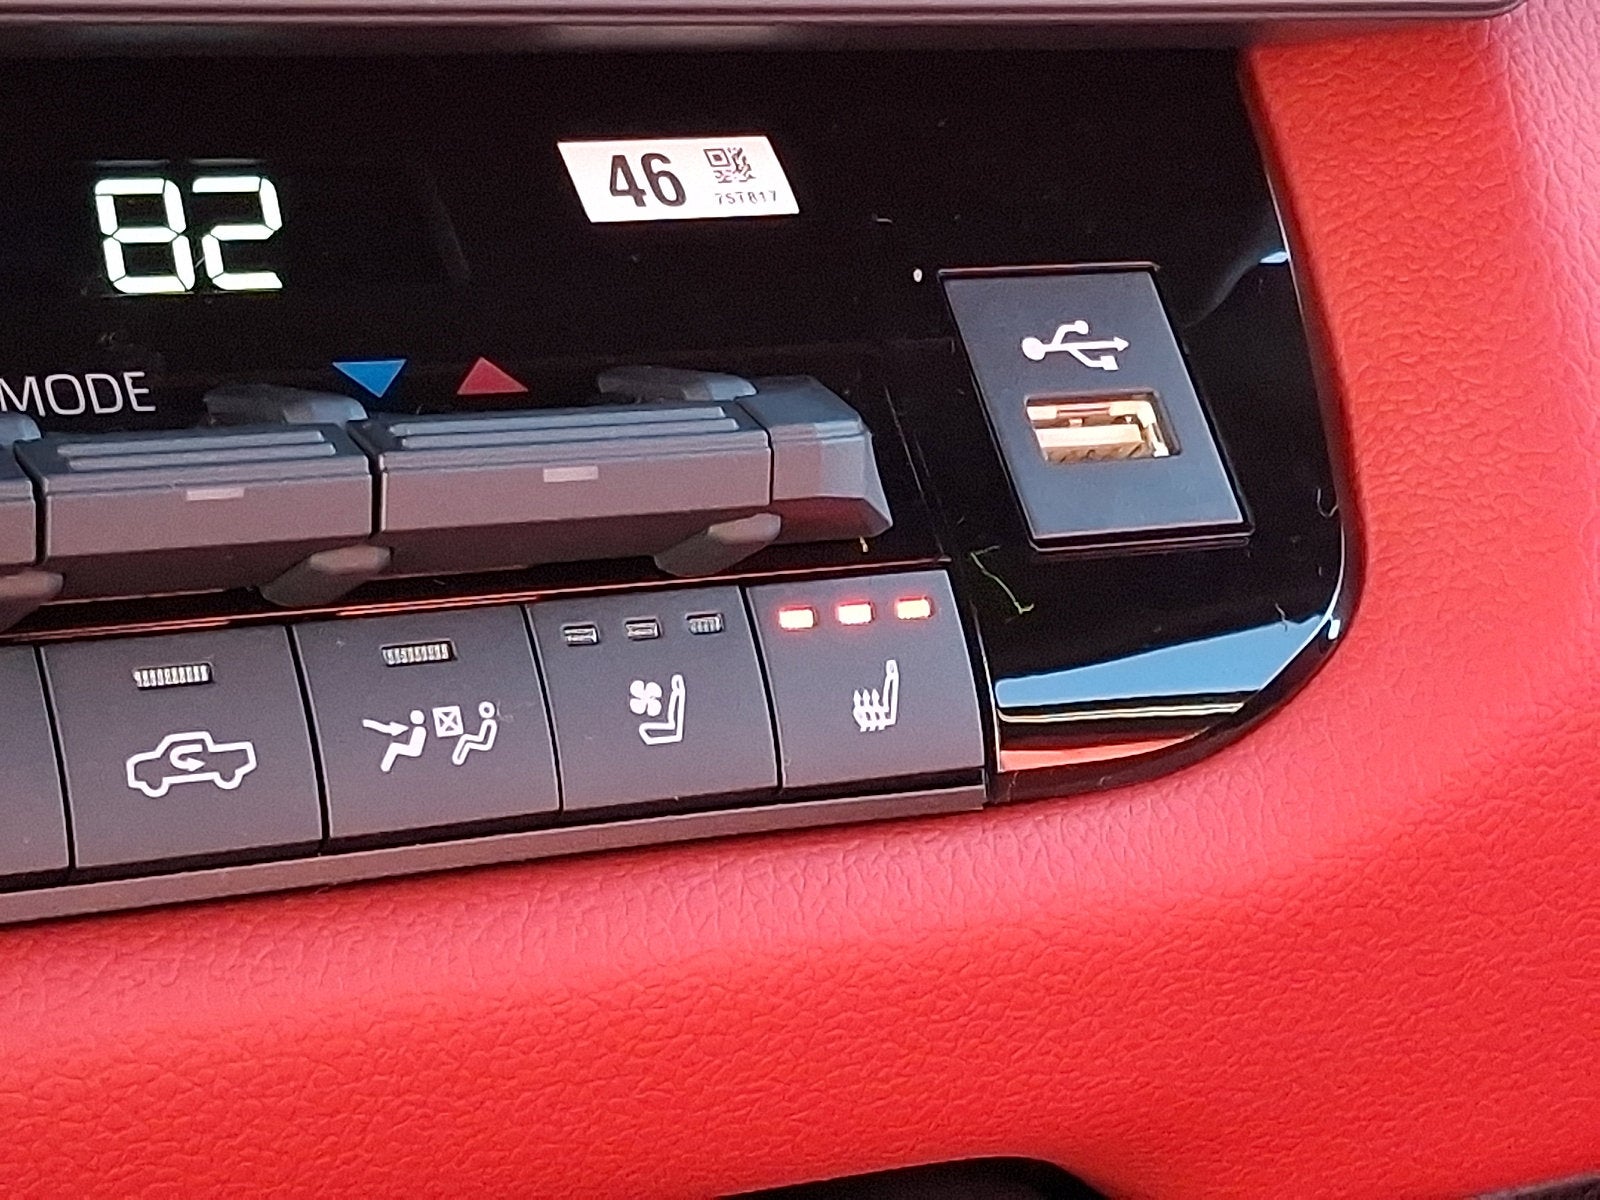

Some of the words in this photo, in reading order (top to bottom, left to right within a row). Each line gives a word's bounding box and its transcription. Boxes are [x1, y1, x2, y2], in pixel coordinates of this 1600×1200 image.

[609, 153, 686, 207] 46
[95, 176, 283, 294] 82
[0, 371, 156, 417] MODE
